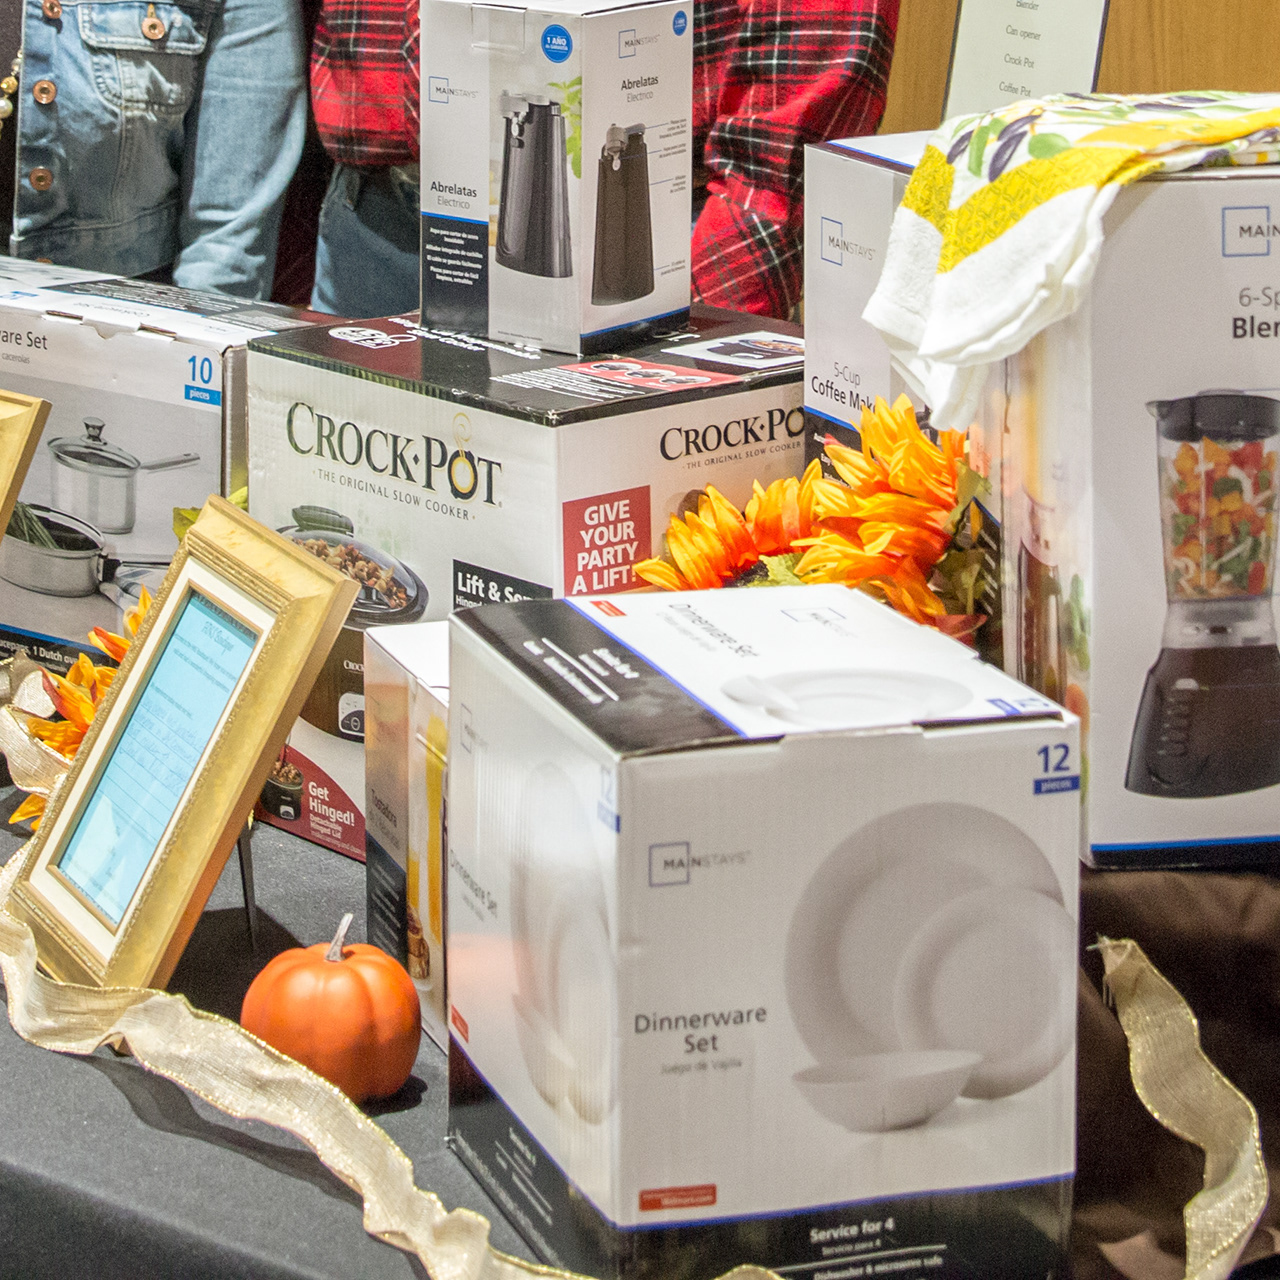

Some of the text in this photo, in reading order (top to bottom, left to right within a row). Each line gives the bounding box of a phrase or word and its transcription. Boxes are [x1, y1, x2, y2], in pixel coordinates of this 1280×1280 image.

[1006, 25, 1041, 41] Can opener
[1004, 53, 1034, 69] Crock Pot
[621, 76, 659, 91] Abrelatas
[999, 81, 1031, 97] Coffee Pot
[430, 181, 477, 197] Abrelatas
[828, 235, 874, 261] MAINSTAYS
[26, 331, 48, 350] Set
[188, 354, 213, 384] 10
[834, 362, 860, 389] 5-Cup
[189, 388, 211, 401] pieces
[811, 376, 875, 413] Coffee Mak
[687, 441, 802, 469] THE ORIGINAL SLOW COOKER
[318, 468, 469, 521] THE ORIGINAL SLOW COOKER
[584, 499, 630, 526] GIVE
[580, 521, 635, 549] YOUR
[577, 541, 639, 572] PARTY
[458, 572, 485, 598] Lift
[488, 581, 501, 602] &
[571, 565, 637, 594] A LIFT!
[33, 646, 37, 655] 1
[39, 647, 63, 663] Dutch
[1037, 743, 1070, 773] 12
[308, 781, 329, 801] Get
[309, 797, 355, 827] Hinged!
[634, 1007, 767, 1034] Dinnerware
[684, 1034, 718, 1054] Set
[810, 1217, 895, 1244] Service for 4
